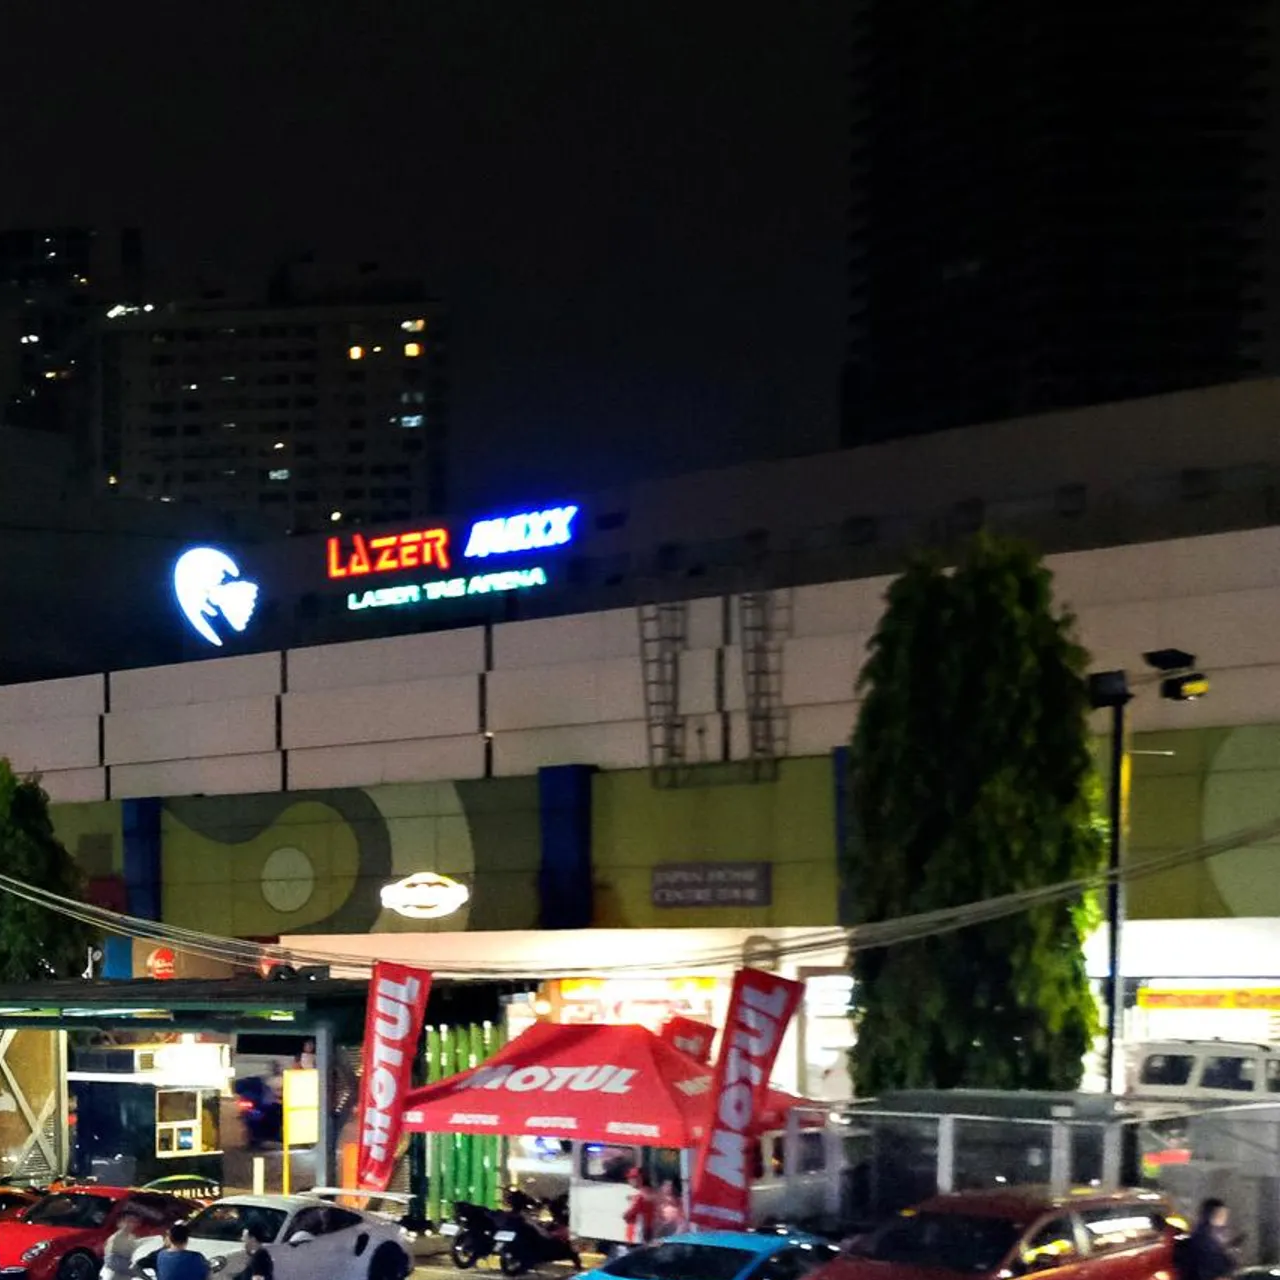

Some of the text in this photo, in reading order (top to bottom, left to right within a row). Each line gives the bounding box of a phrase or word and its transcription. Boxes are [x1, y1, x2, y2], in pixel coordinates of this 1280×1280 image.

[328, 528, 450, 578] LAZER
[363, 975, 421, 1162] MOTUL
[456, 1064, 640, 1094] MOTUL
[705, 984, 790, 1189] MOTUL
